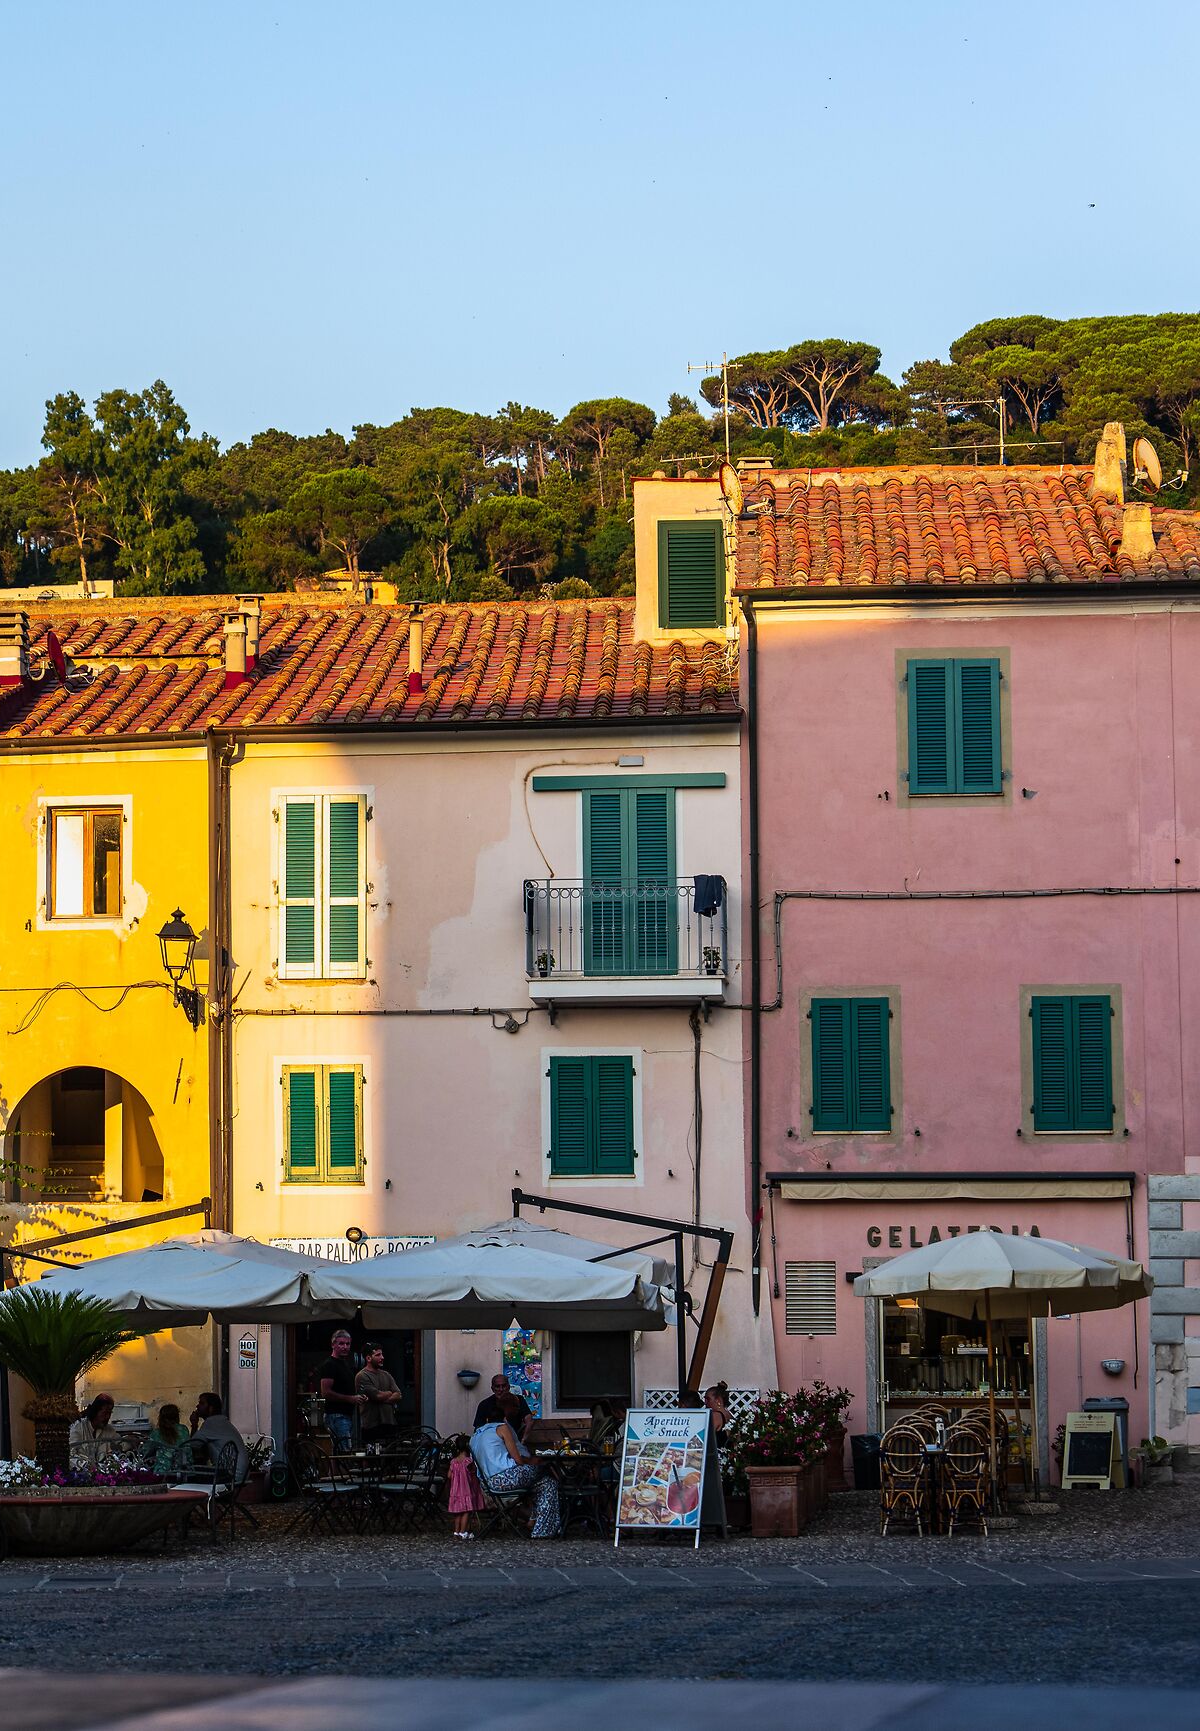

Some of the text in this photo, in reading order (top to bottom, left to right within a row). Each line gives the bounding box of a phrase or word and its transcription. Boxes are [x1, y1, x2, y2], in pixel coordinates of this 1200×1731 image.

[867, 1225, 1041, 1248] GELATA
[327, 1242, 369, 1262] PALMO
[240, 1341, 256, 1350] HOT
[240, 1359, 256, 1368] DOG
[643, 1416, 690, 1429] Aperitivi
[658, 1427, 689, 1437] Snack
